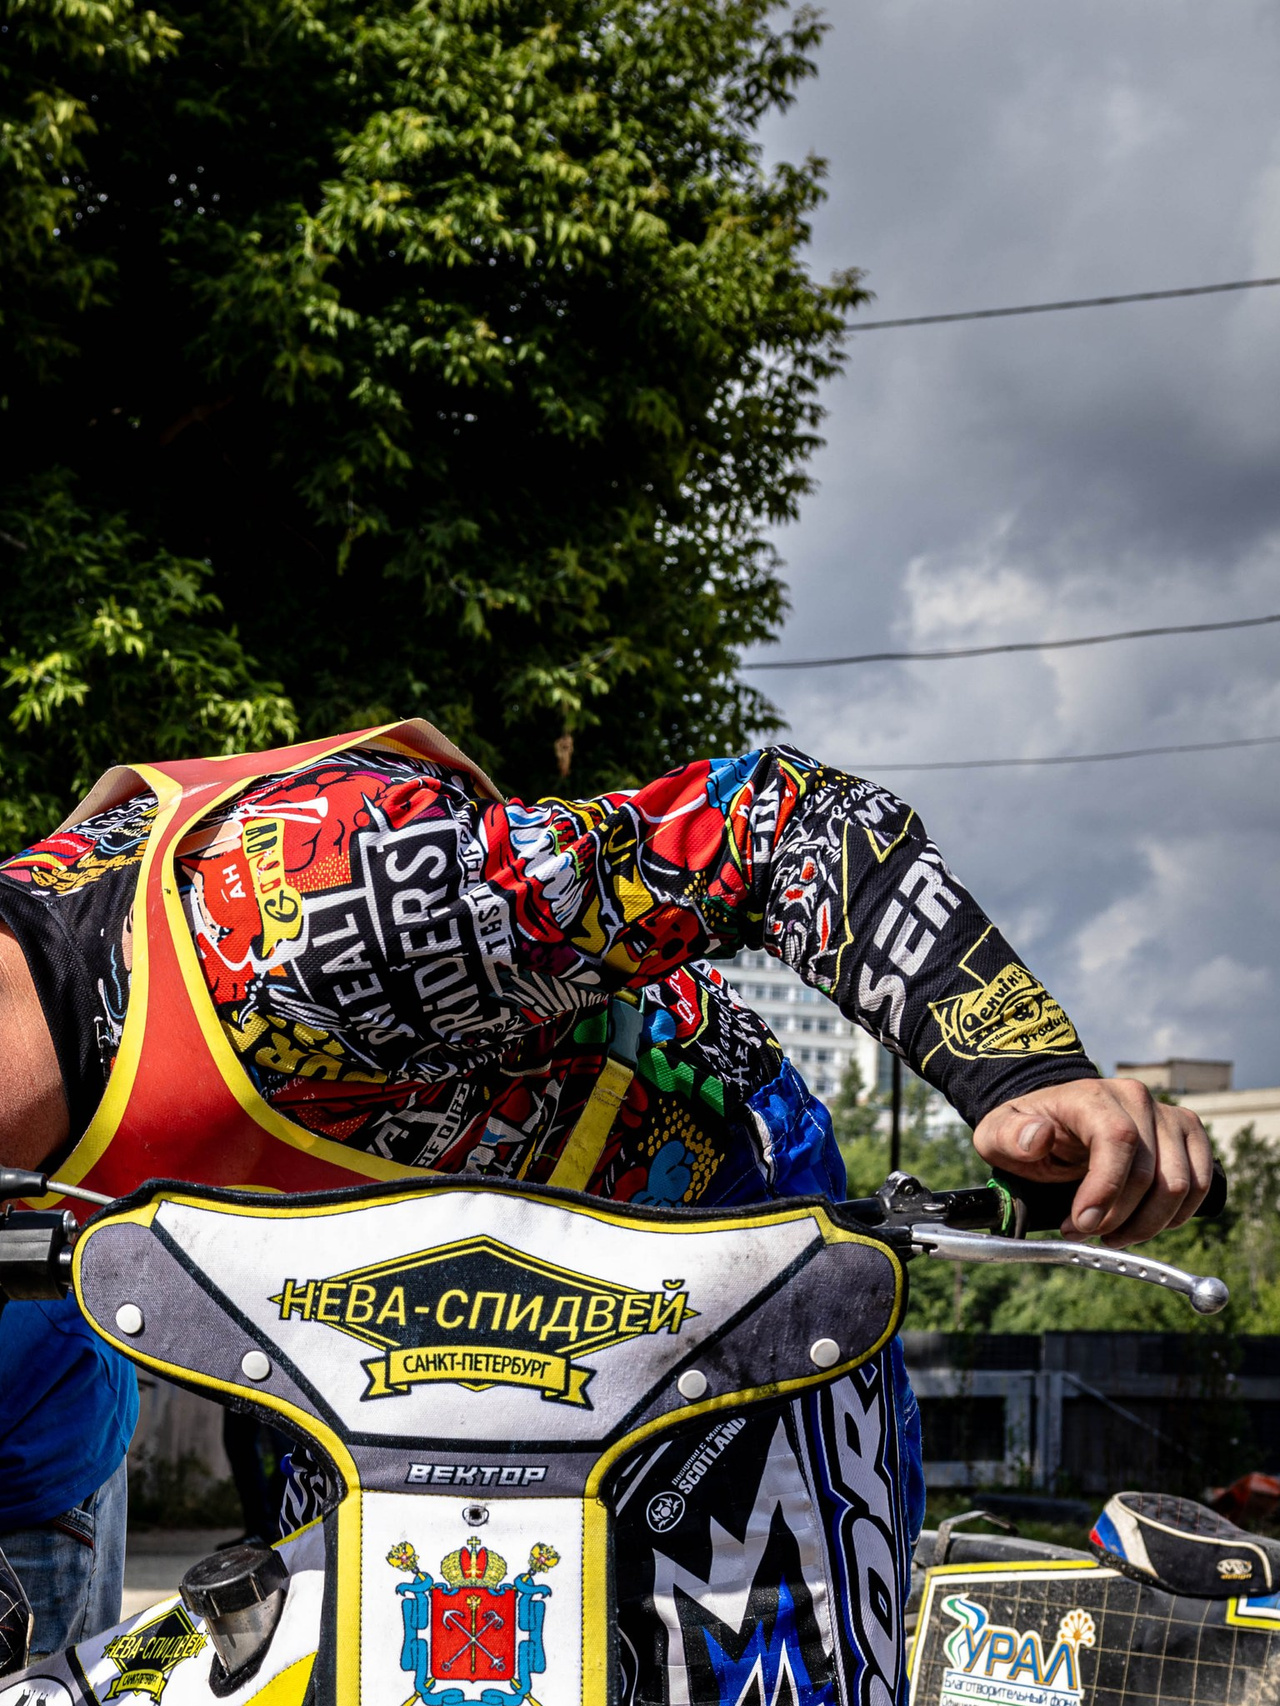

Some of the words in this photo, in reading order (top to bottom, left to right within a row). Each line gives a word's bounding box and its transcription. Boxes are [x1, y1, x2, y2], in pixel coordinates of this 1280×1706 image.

[278, 1278, 687, 1335] НЕВА-СПИДВЕЙ
[402, 1351, 551, 1382] САНКТ-ПЕТЕРБУРГ
[406, 1461, 548, 1486] ВЕКТОР
[678, 1417, 747, 1495] SCOTLAND
[962, 1624, 1078, 1690] УРАЛ
